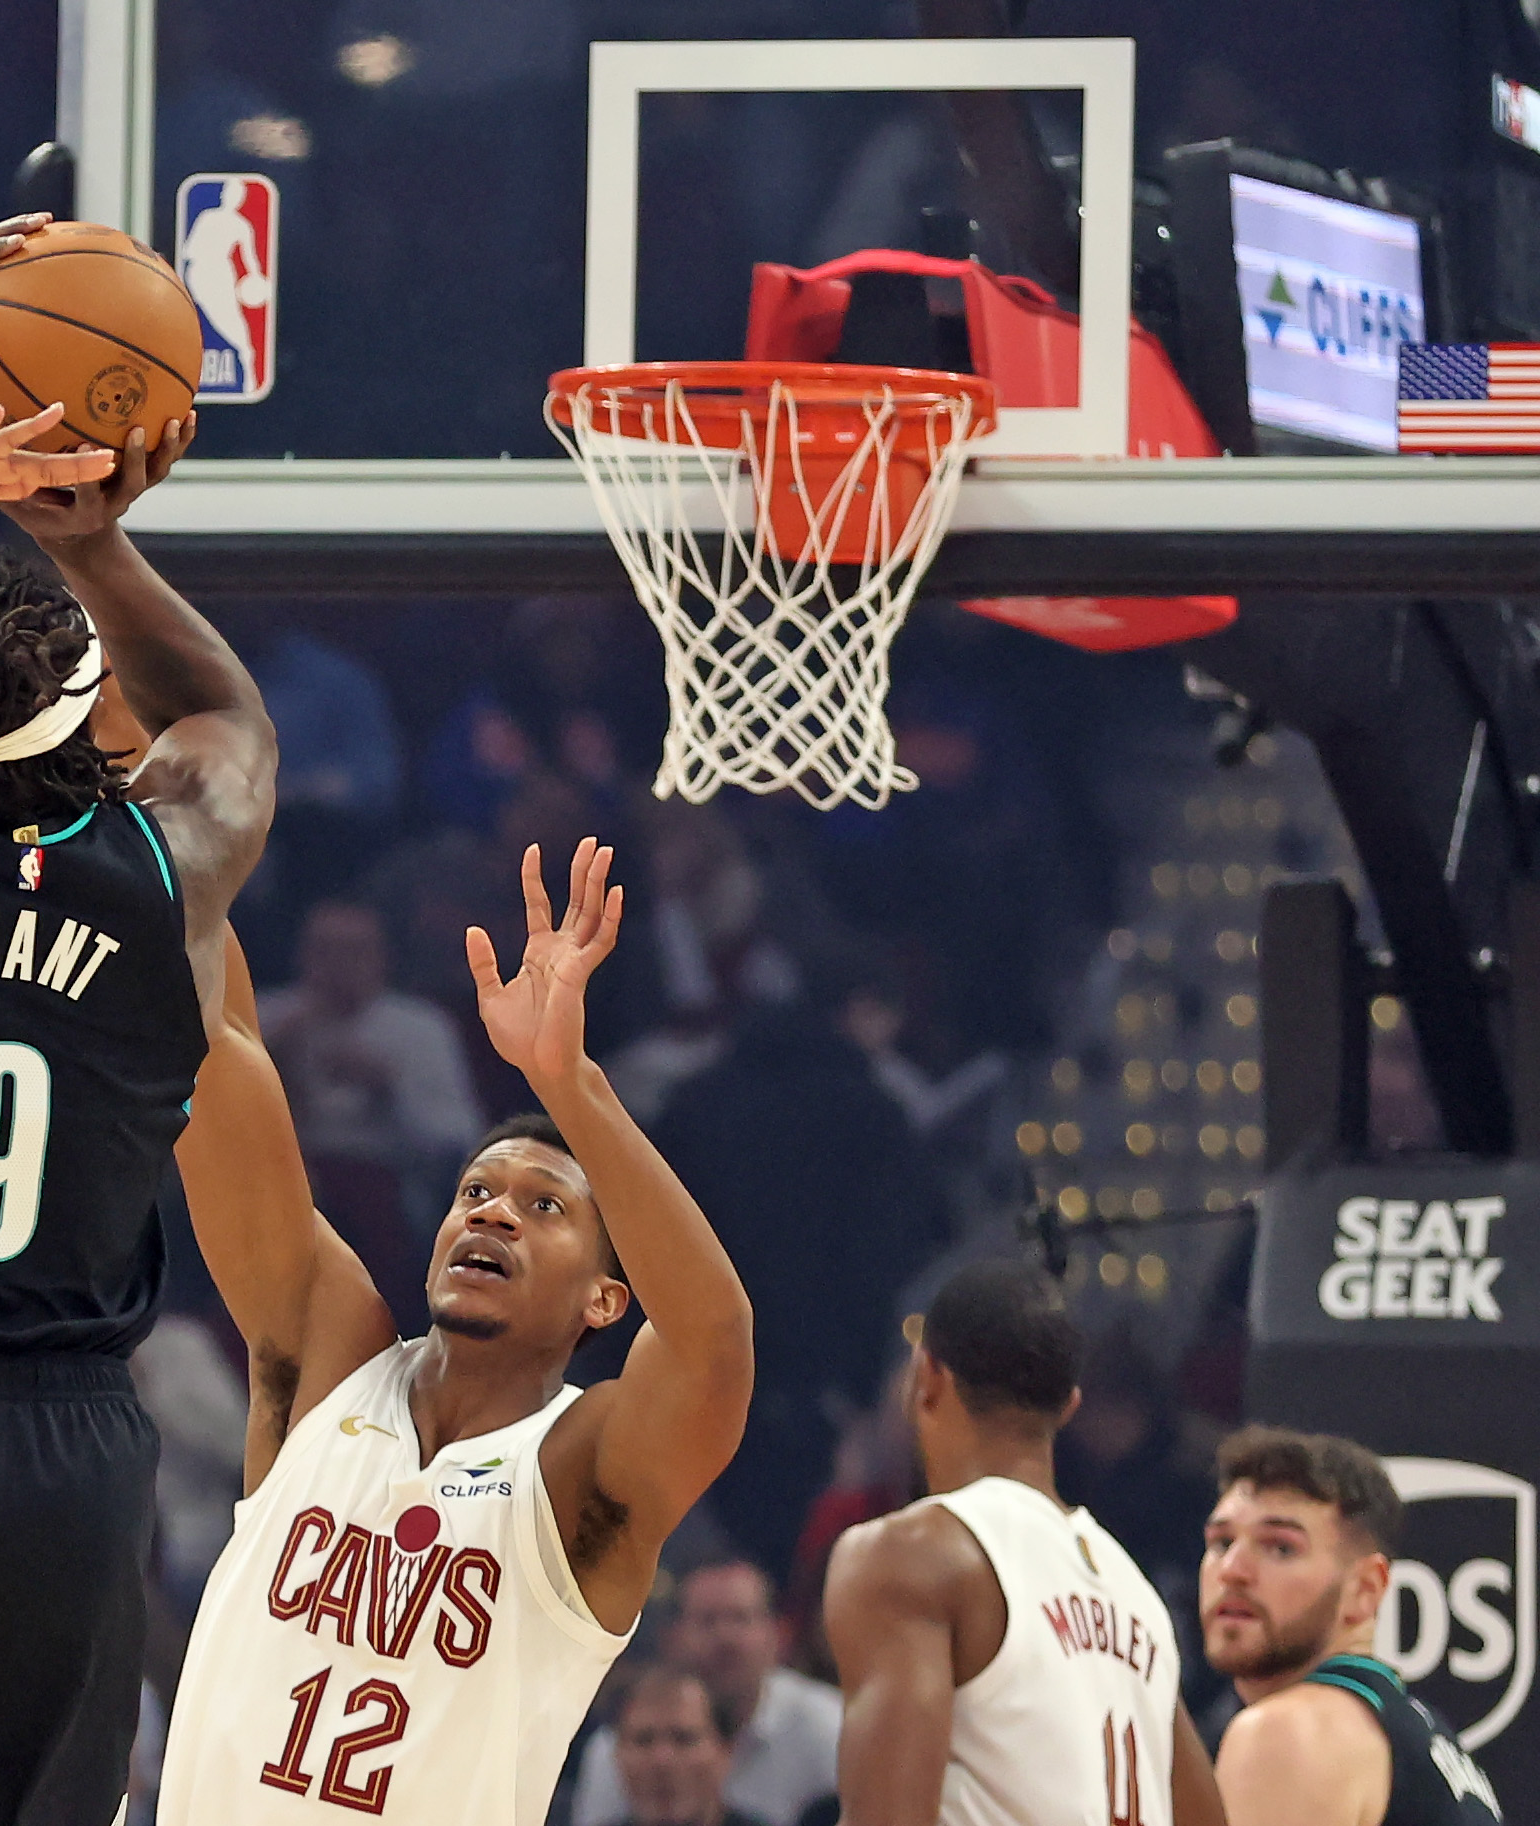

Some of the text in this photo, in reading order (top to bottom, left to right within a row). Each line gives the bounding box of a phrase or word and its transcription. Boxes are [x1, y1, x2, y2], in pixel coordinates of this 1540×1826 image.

[1334, 1196, 1505, 1260] SEAT
[1317, 1256, 1504, 1322] GEEK
[441, 1480, 512, 1498] CLIFFS
[268, 1505, 501, 1670] CAVS
[1040, 1594, 1159, 1684] MOBLEY
[260, 1665, 410, 1815] 12
